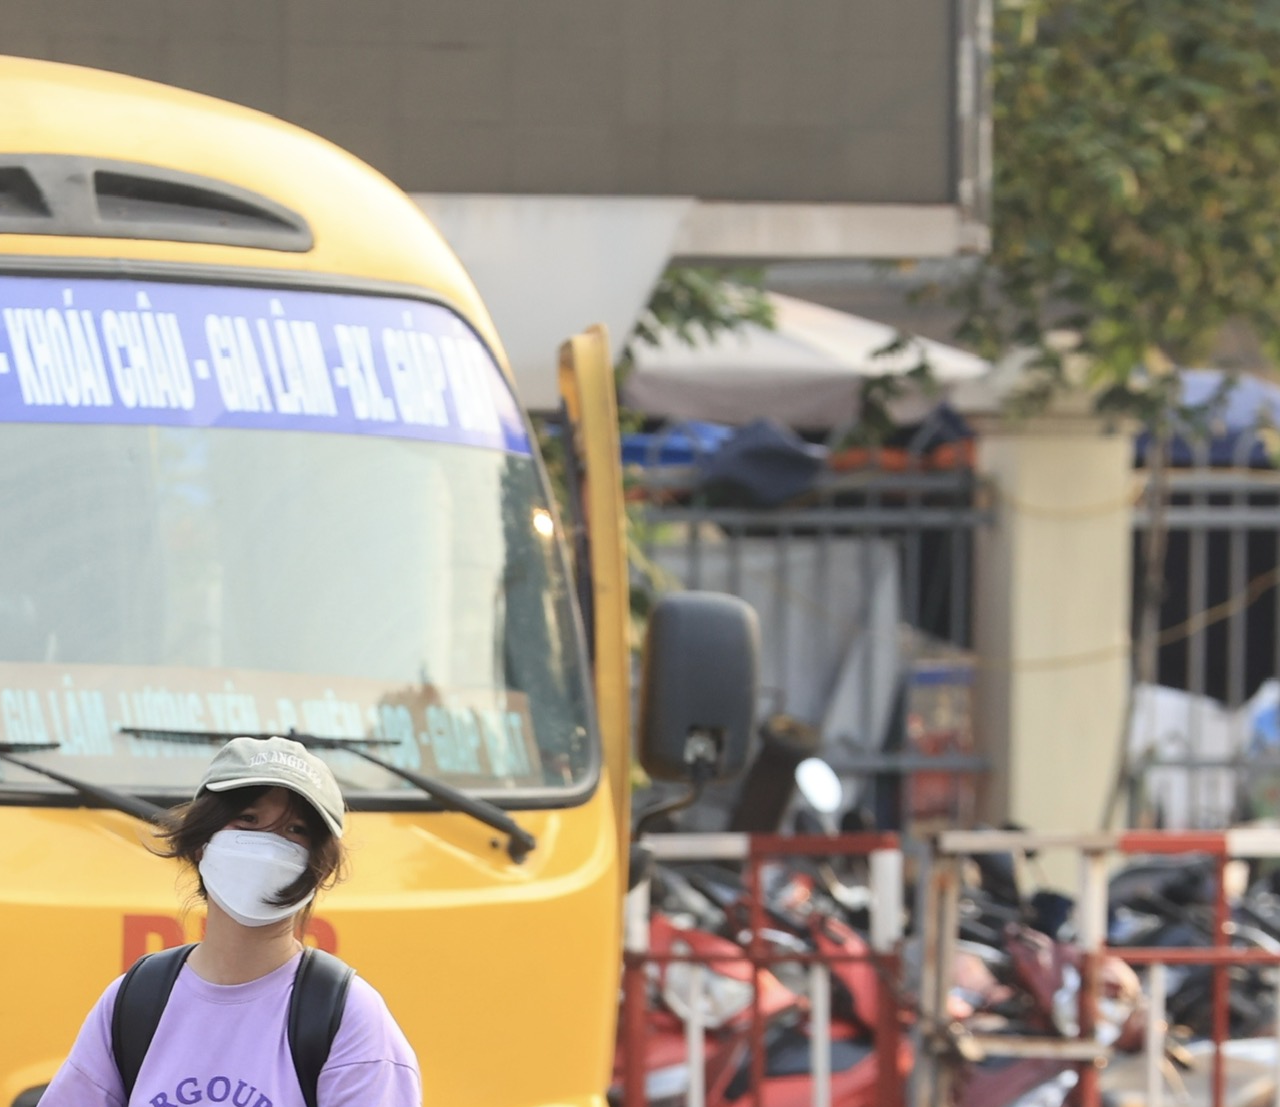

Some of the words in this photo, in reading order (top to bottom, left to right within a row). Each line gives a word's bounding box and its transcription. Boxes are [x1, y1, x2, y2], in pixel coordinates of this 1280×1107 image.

[101, 291, 195, 410] CHÂU
[205, 313, 273, 413] GIA
[257, 298, 338, 417] LÂM
[47, 673, 115, 756] LÂM
[248, 752, 269, 768] LOS
